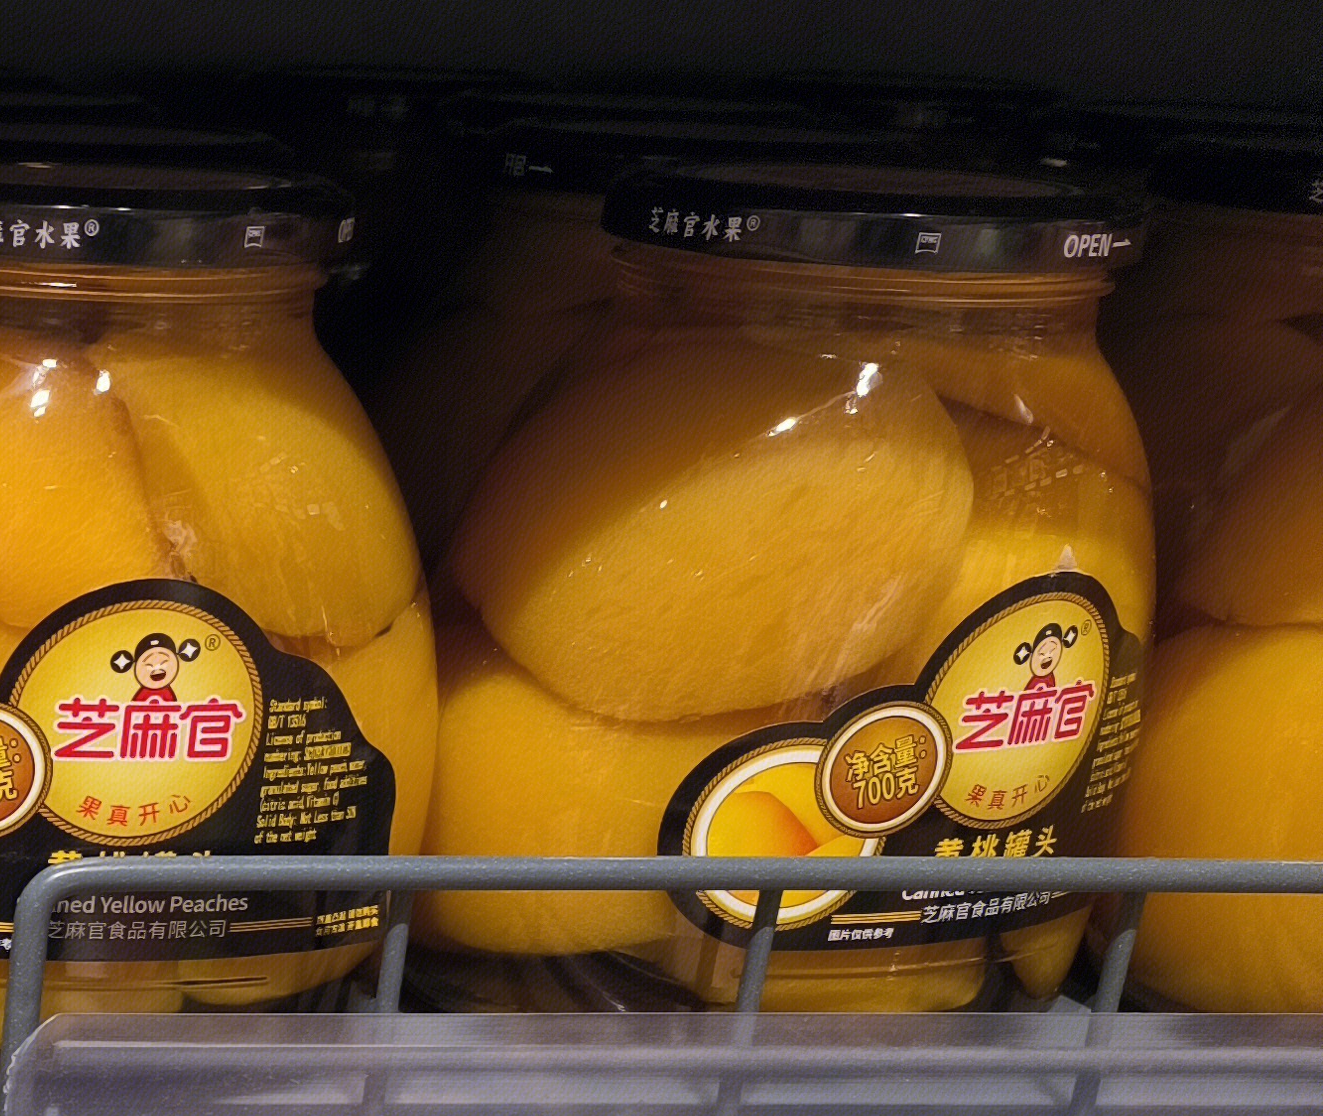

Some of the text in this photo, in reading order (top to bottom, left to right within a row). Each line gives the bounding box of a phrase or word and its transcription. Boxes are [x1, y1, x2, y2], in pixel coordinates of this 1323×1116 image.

[649, 206, 744, 243] 芝麻官水果
[1064, 233, 1113, 259] OPEN
[55, 697, 243, 763] 芝麻官
[955, 680, 1095, 750] 芝麻官
[844, 733, 927, 784] 净含量:
[852, 768, 921, 809] 700克
[964, 774, 1051, 811] 果真开心
[77, 793, 192, 828] 果真开心
[935, 825, 1058, 858] 黄桃罐头
[100, 894, 248, 915] Yellow Peaches
[921, 892, 1051, 924] 芝麻官食品有限公司
[48, 919, 228, 941] 芝麻官食品有限公司
